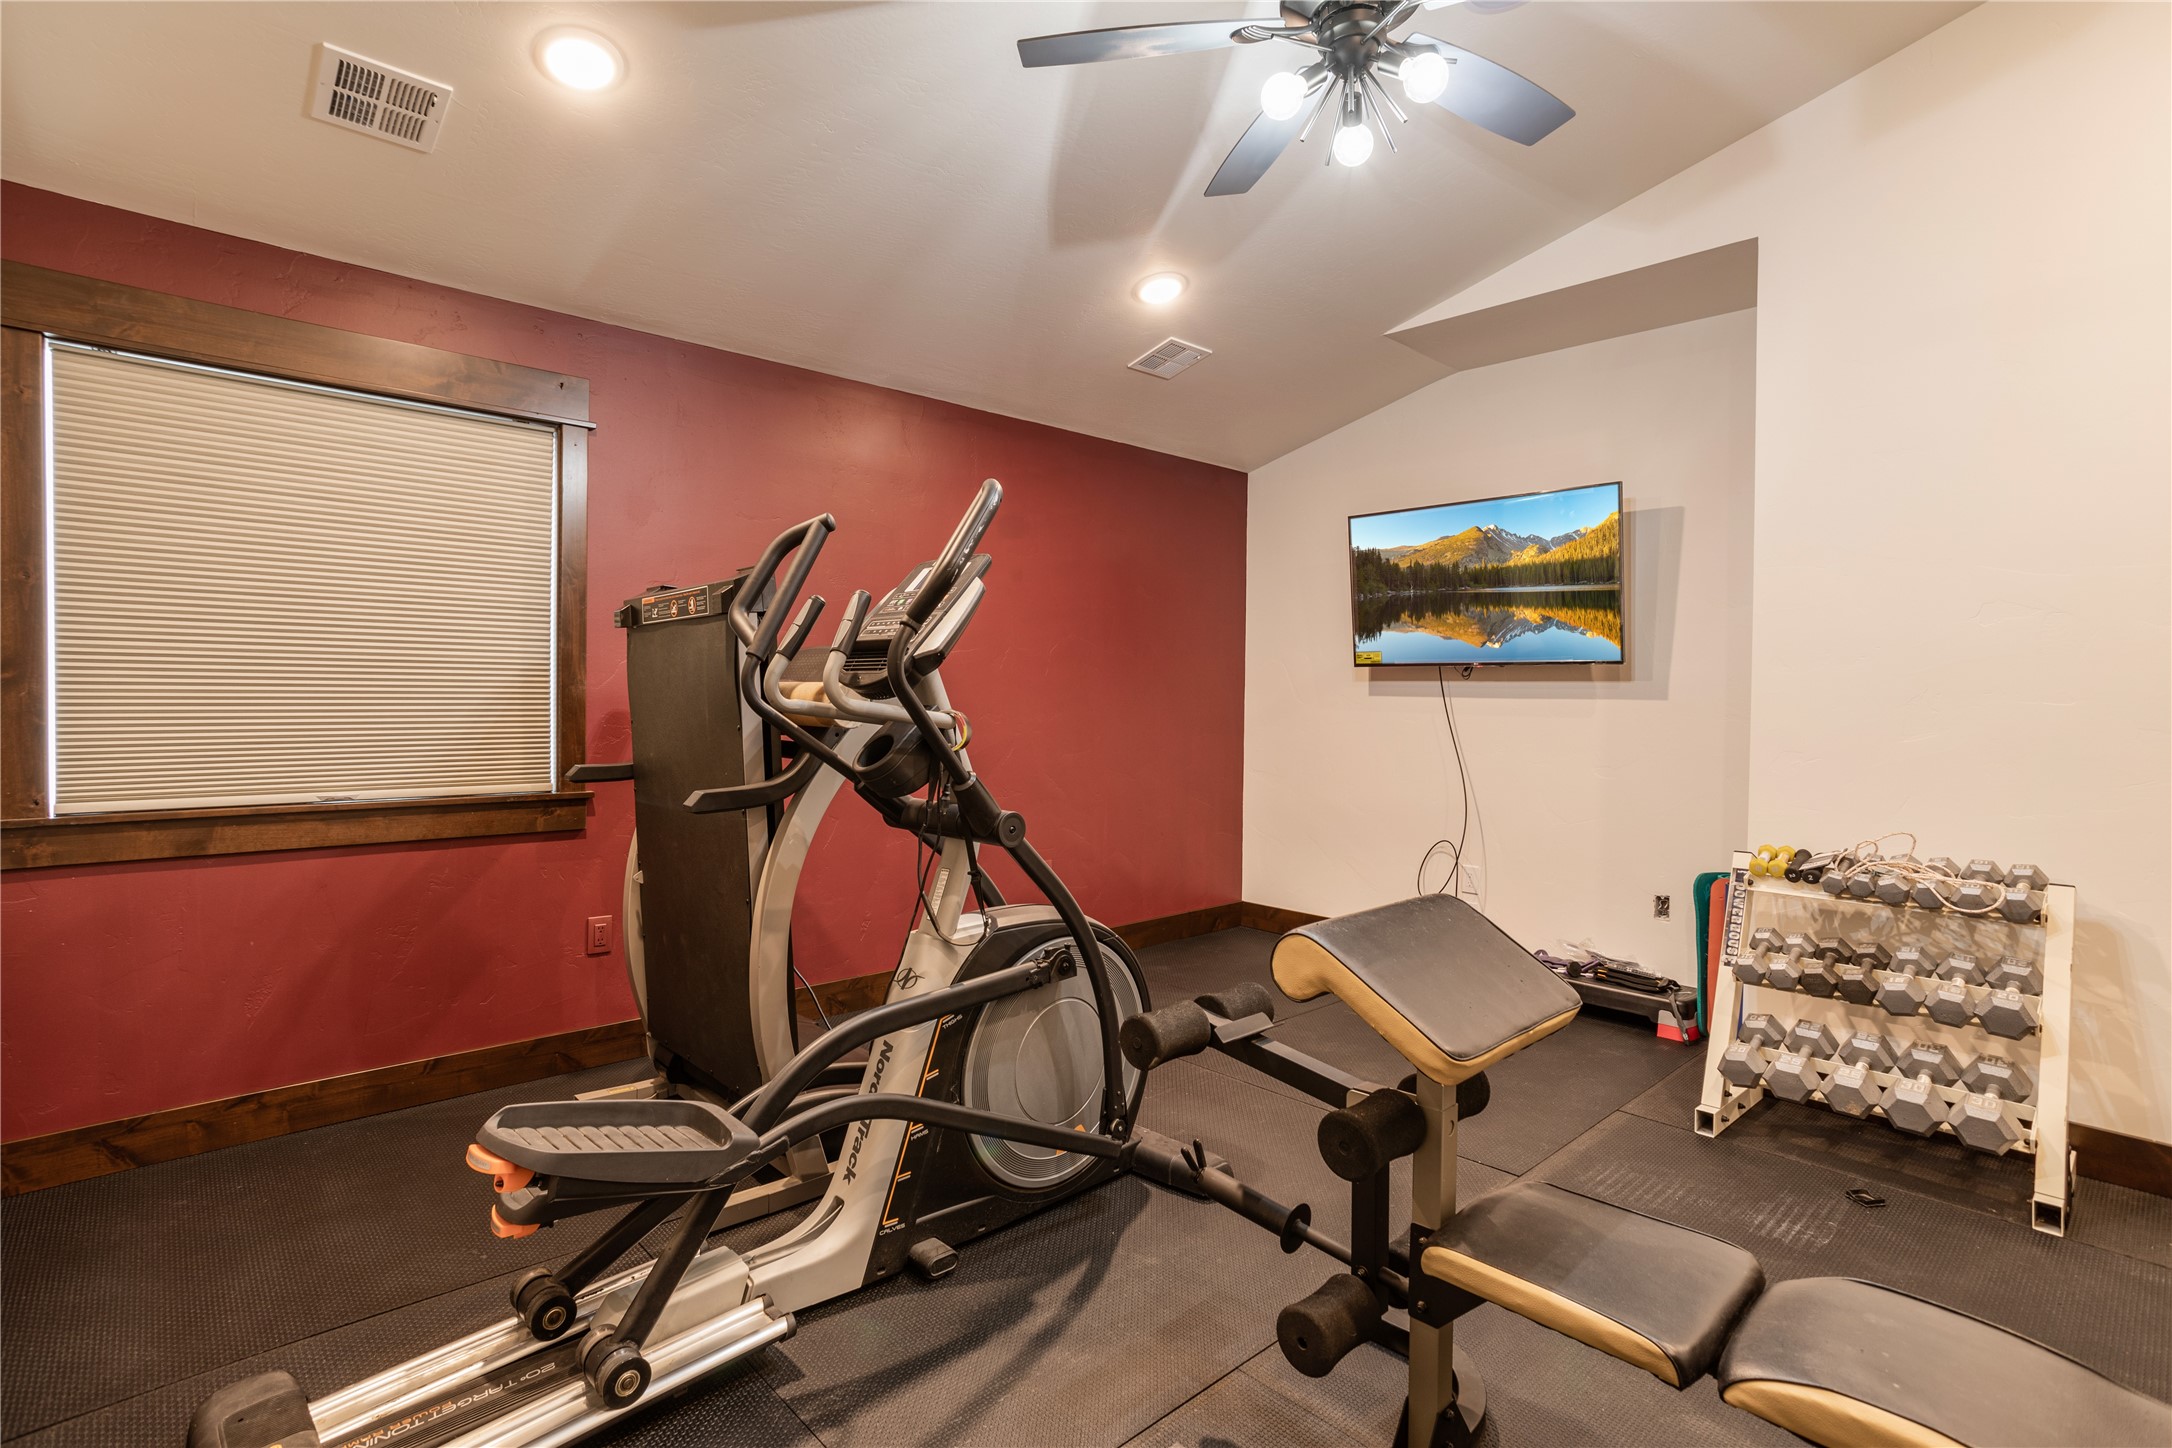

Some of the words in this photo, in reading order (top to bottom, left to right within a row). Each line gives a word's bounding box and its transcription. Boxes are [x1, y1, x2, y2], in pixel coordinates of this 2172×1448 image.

[1901, 1080, 1925, 1092] 30
[1971, 1096, 1997, 1109] 30
[843, 1039, 894, 1185] NordTrack
[879, 1223, 906, 1236] CALVES
[428, 1379, 518, 1420] TARGET
